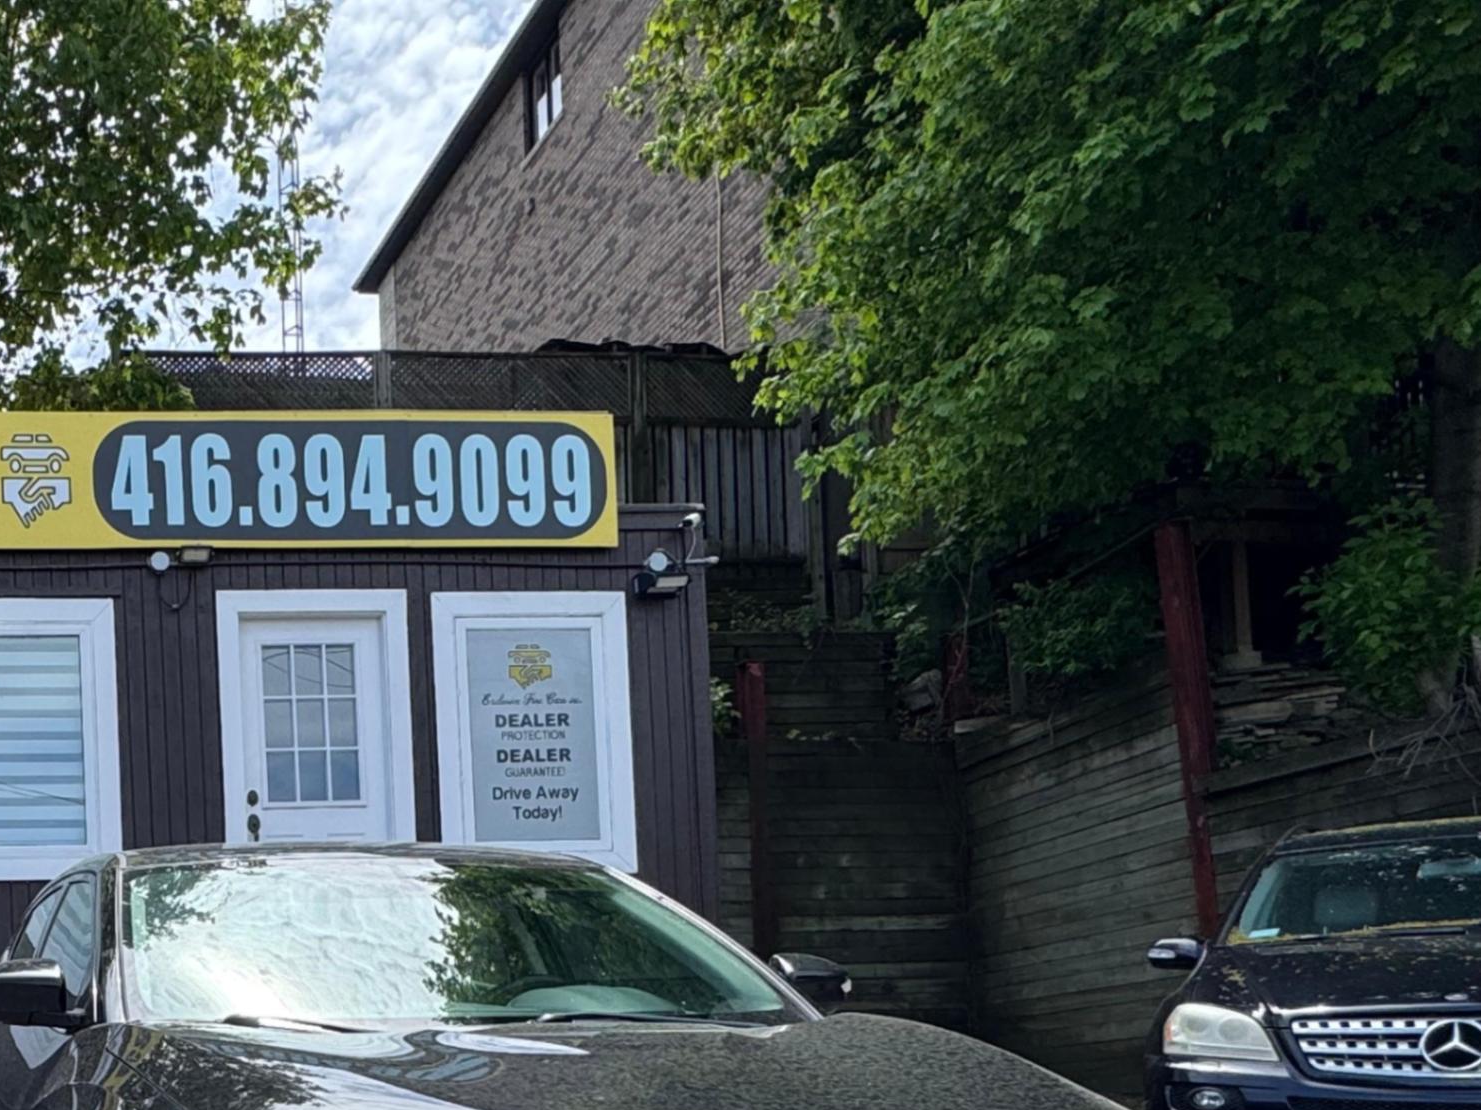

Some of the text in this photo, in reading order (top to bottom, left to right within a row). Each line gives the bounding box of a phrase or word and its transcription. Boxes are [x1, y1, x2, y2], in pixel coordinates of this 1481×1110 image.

[111, 432, 592, 528] 416.894.9099
[495, 713, 570, 728] DEALER
[501, 730, 566, 741] PROTECTION
[496, 748, 572, 763] DEALER
[492, 785, 579, 802] Drive Away
[512, 805, 563, 822] Today!
